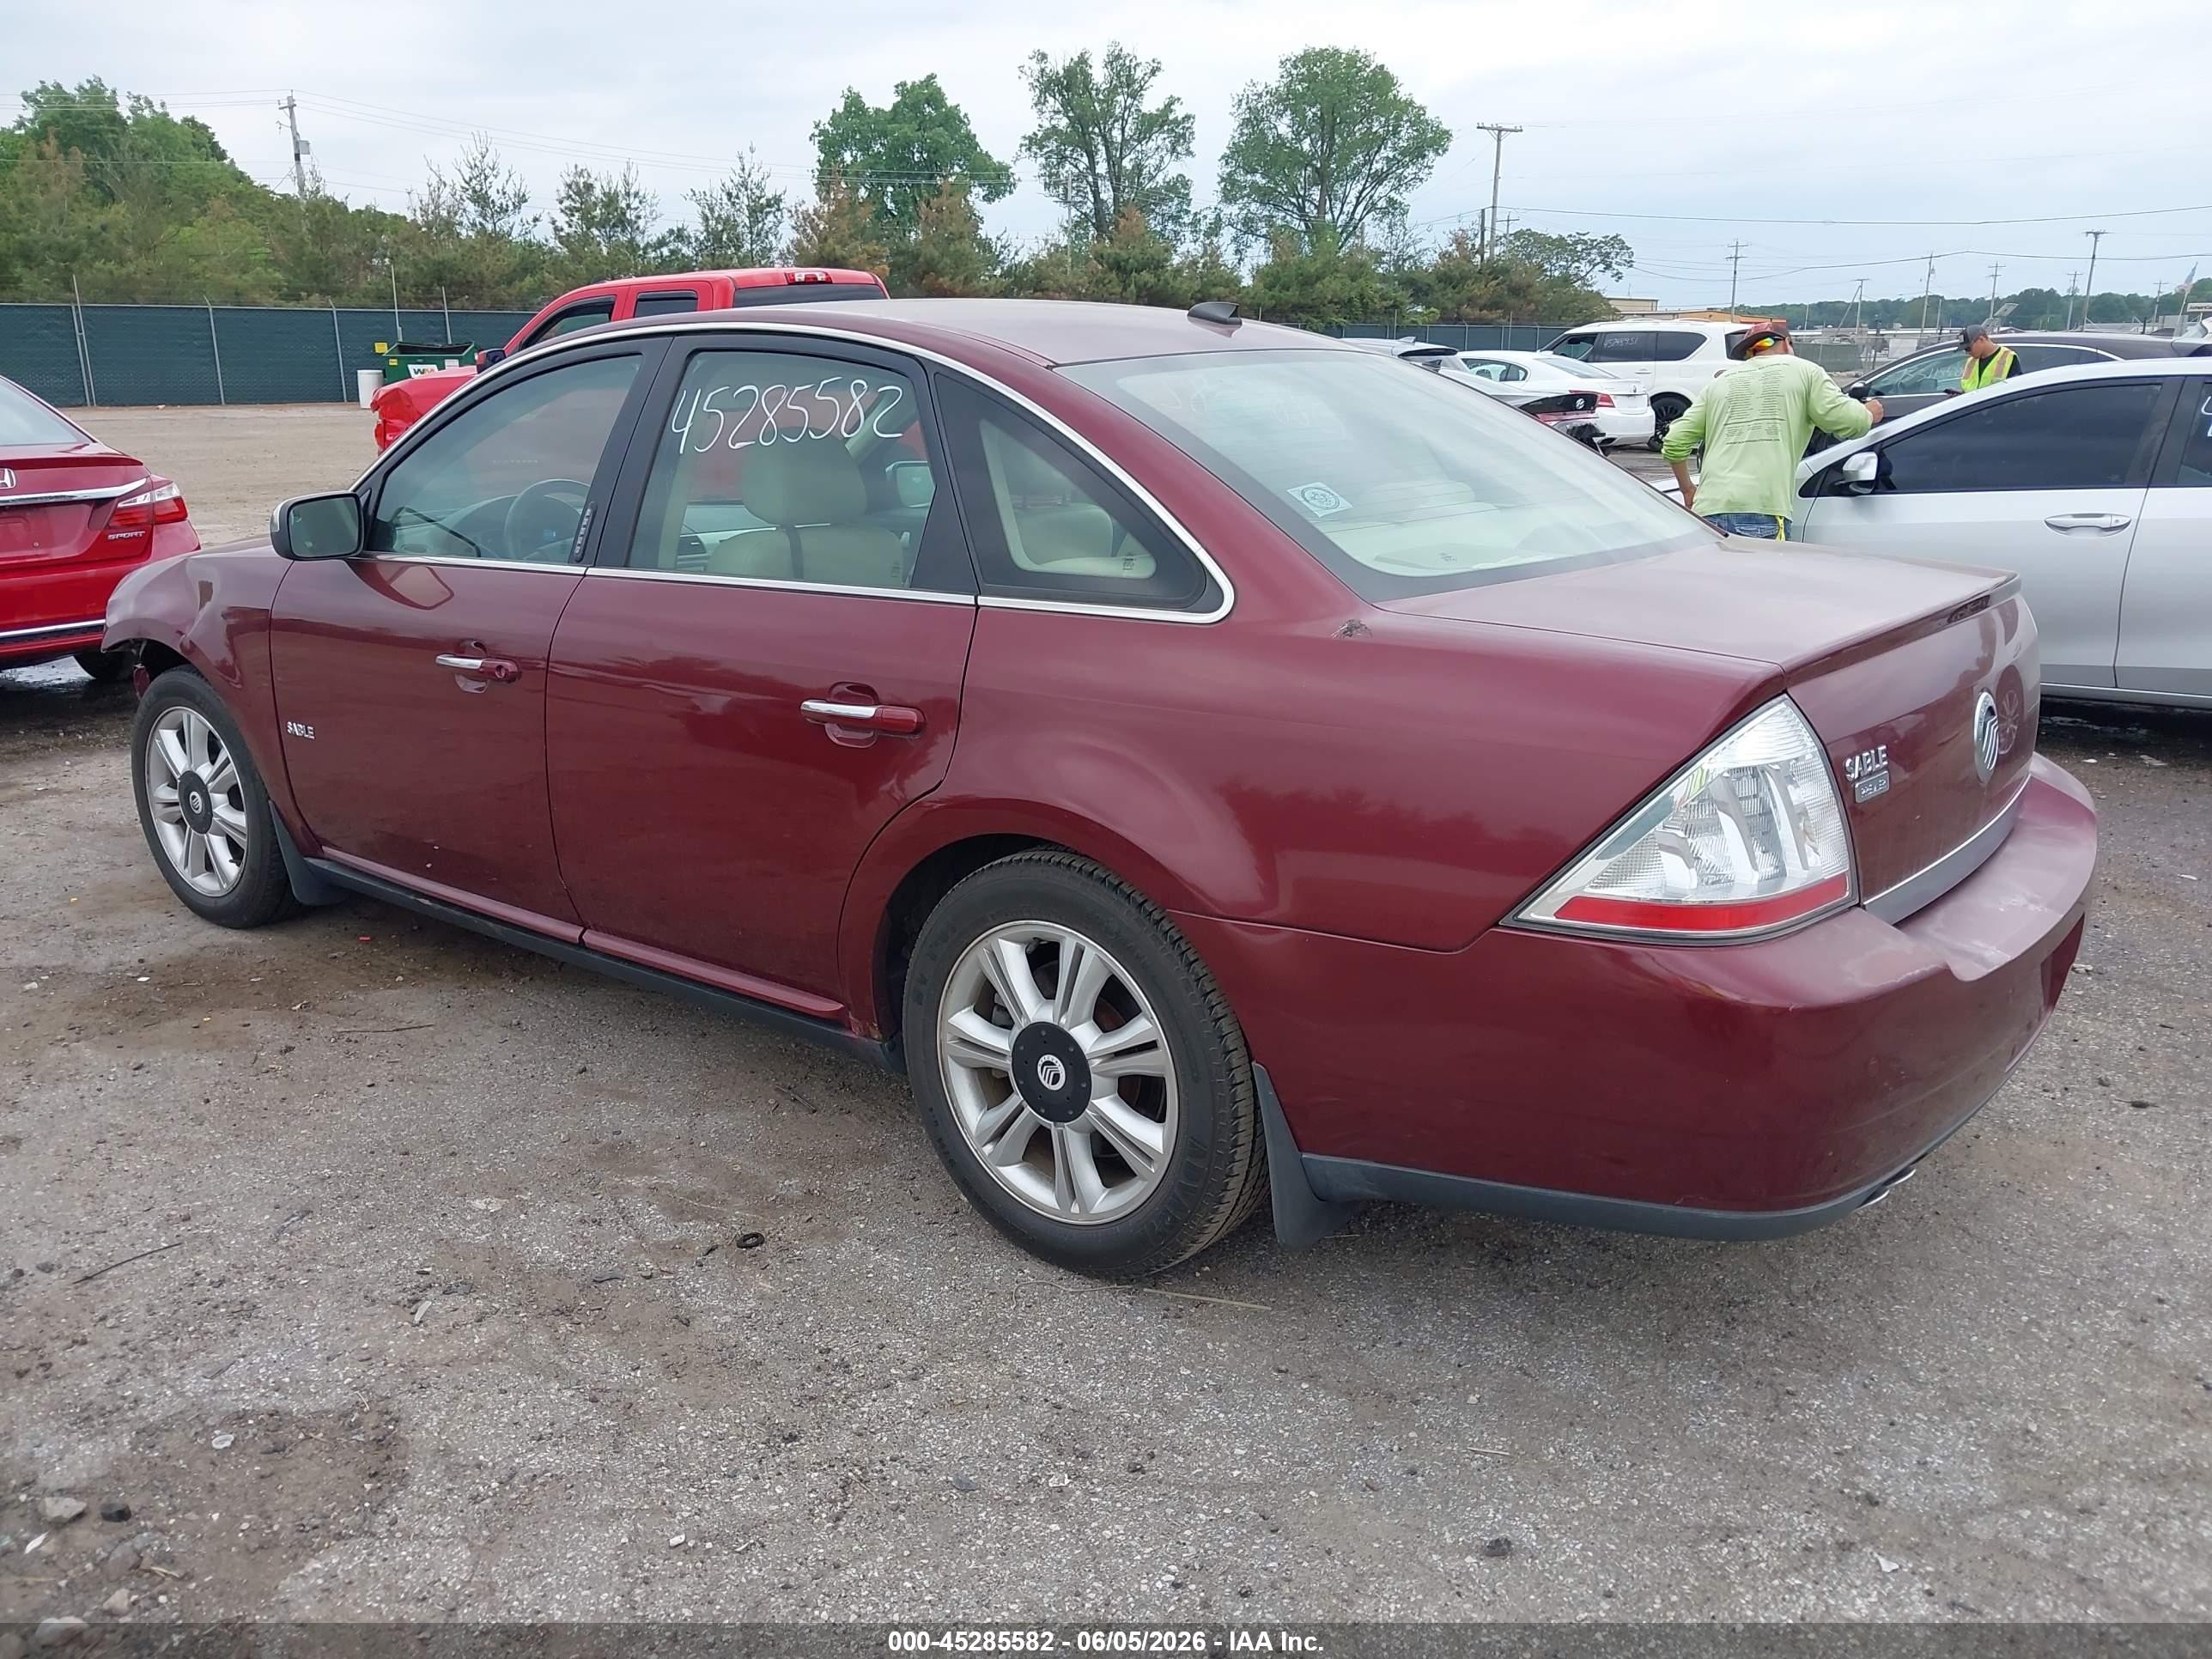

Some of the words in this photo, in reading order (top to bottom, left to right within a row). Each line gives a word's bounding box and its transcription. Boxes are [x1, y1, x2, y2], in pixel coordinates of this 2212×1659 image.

[672, 376, 903, 454] 45285582
[106, 531, 146, 540] SPORT
[287, 721, 315, 739] SABLE
[1844, 744, 1888, 781] SABLE
